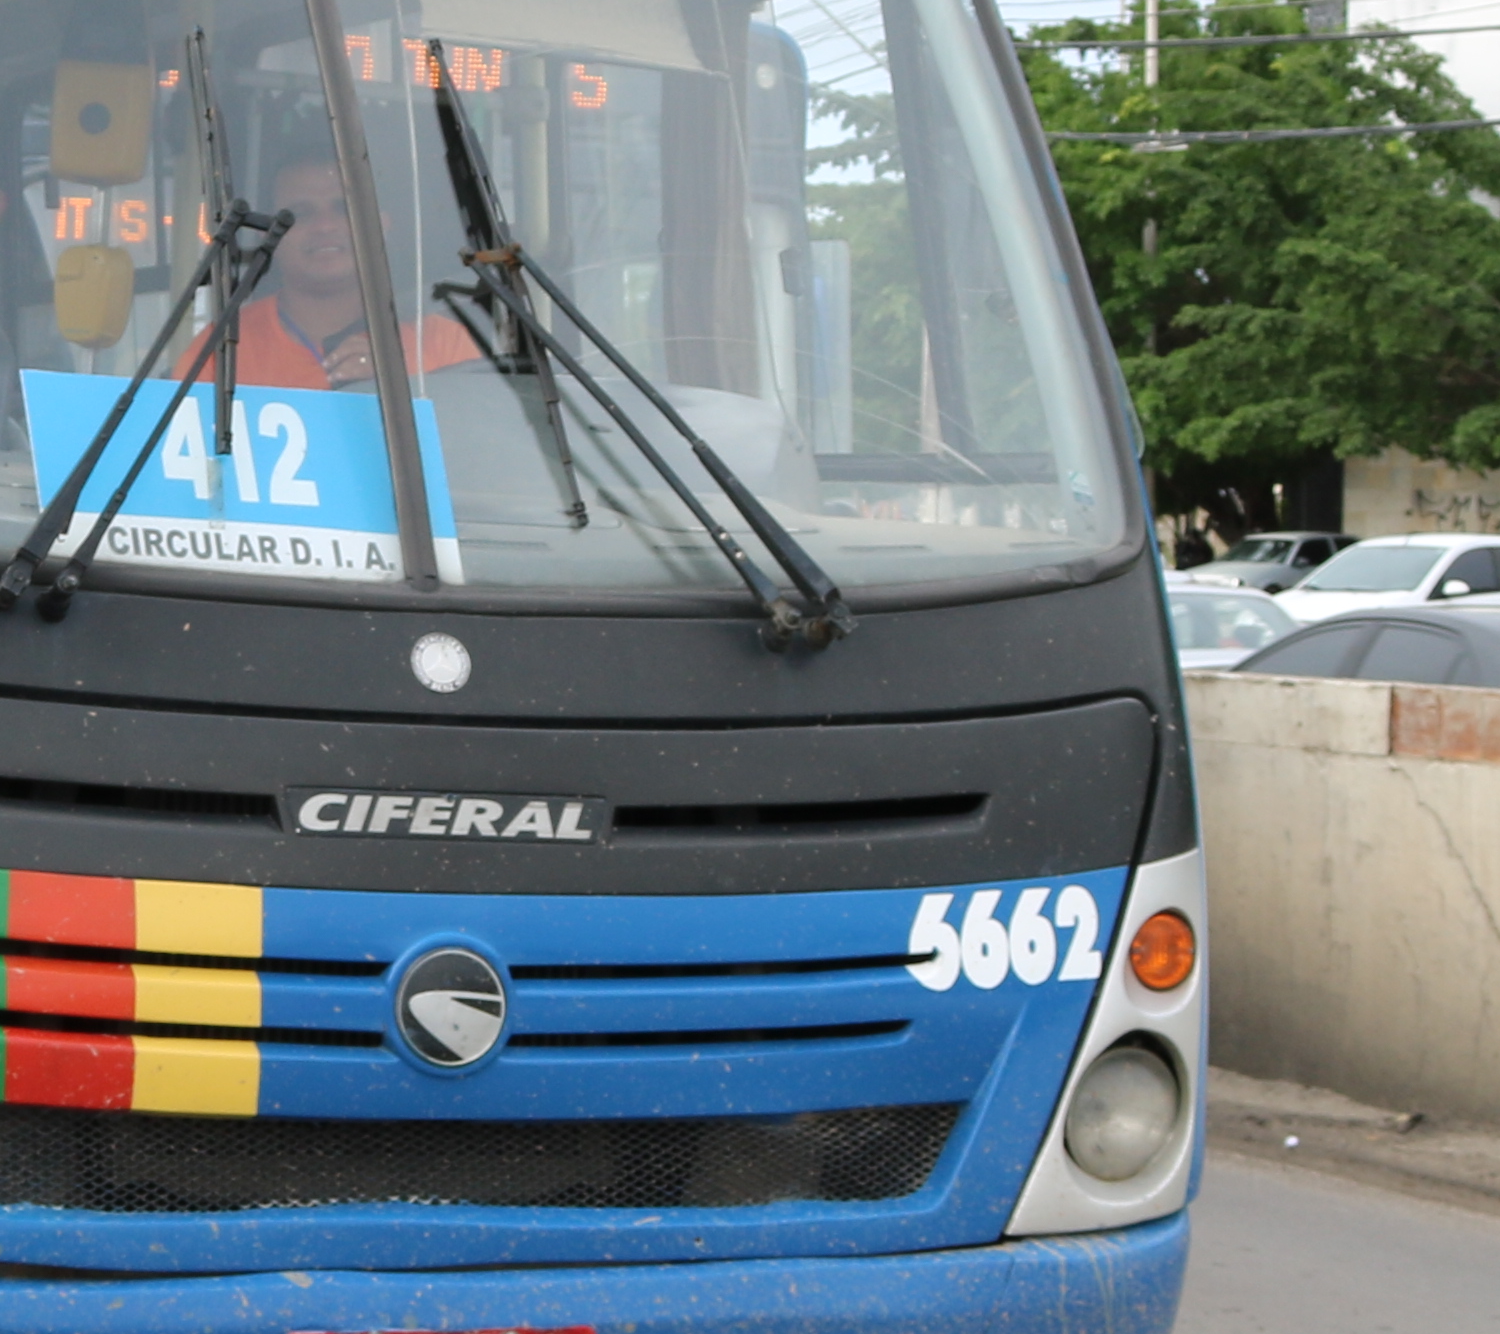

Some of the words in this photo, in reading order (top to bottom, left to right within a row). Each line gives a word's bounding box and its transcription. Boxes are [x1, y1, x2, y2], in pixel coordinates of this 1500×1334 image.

[161, 397, 319, 507] 412
[108, 526, 280, 563] CIRCULAR
[290, 535, 322, 566] D.
[332, 540, 353, 568] I.
[366, 542, 395, 571] A.
[296, 793, 593, 840] CIFERAL
